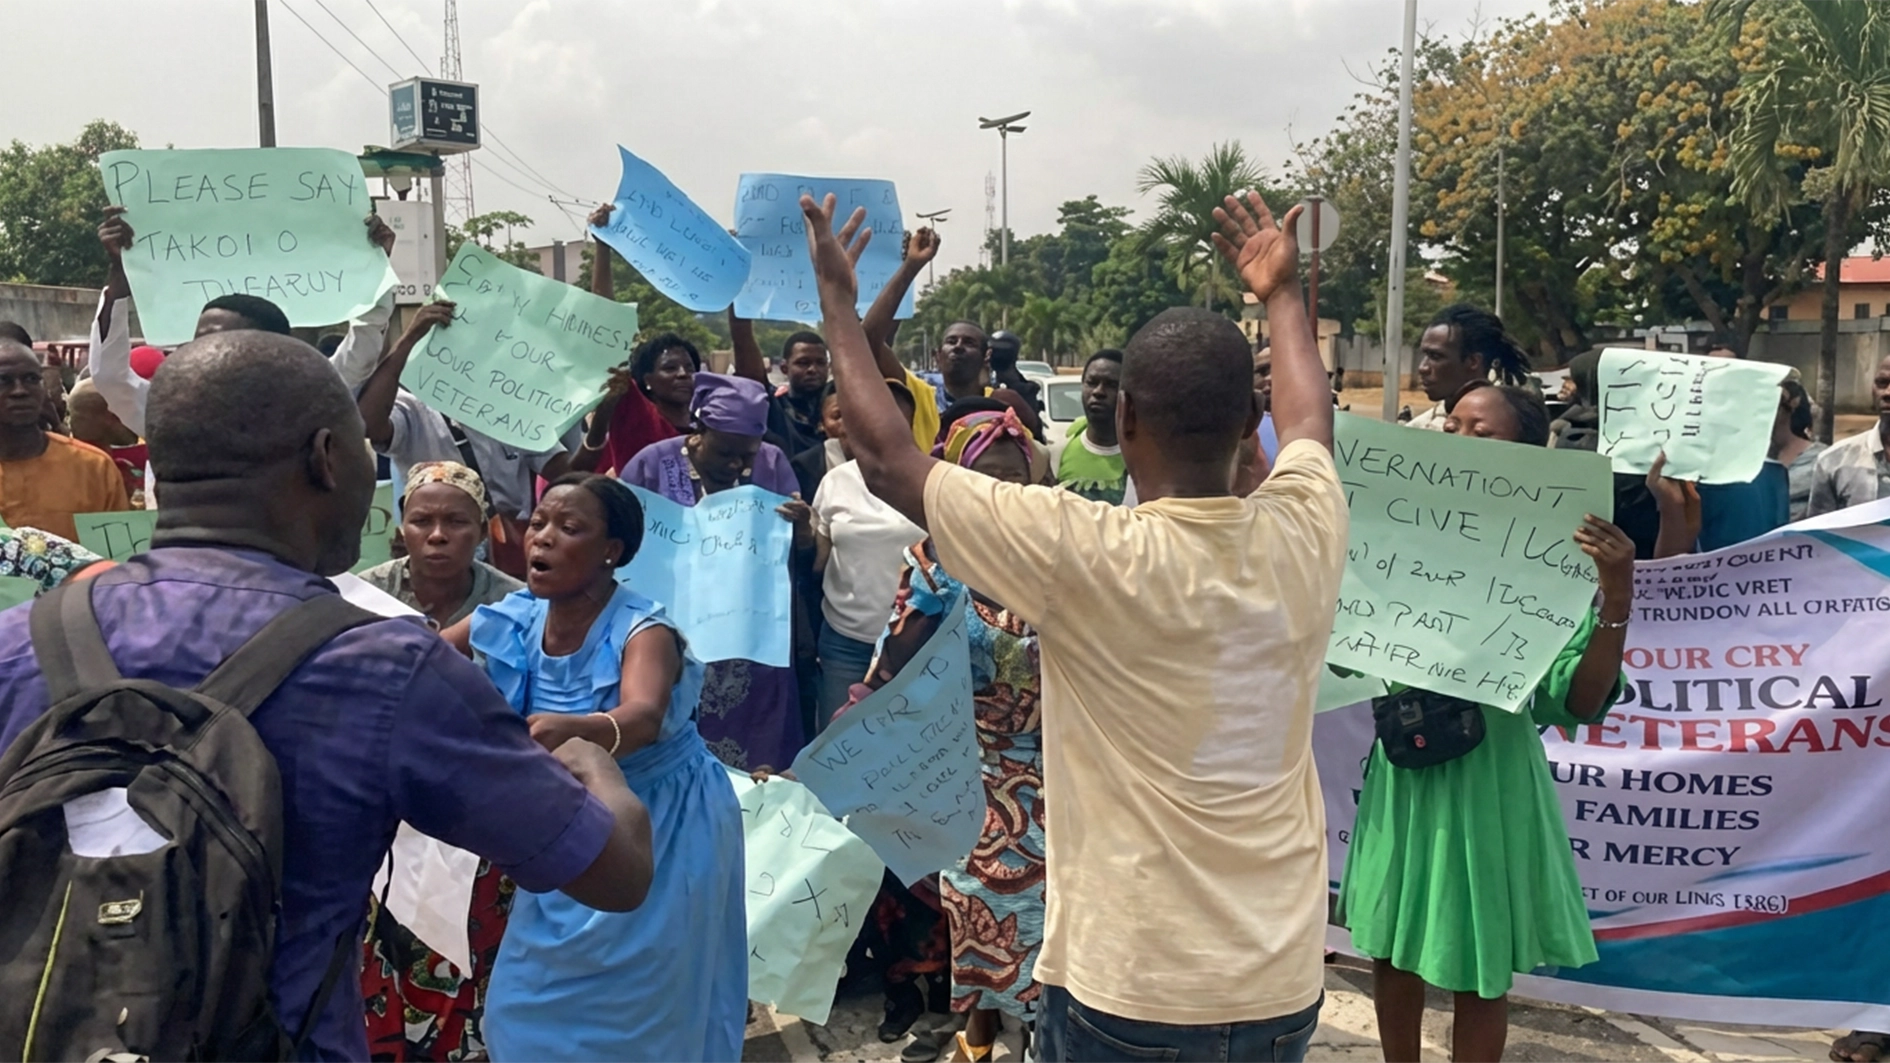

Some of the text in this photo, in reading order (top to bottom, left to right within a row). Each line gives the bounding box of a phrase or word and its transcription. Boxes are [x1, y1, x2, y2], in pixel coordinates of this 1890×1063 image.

[109, 160, 358, 206] PLEASE SAY
[418, 366, 546, 442] VETERANS
[1736, 578, 1792, 596] VRET
[1757, 601, 1797, 617] ALL
[1623, 643, 1810, 670] OUR CRY
[1557, 713, 1890, 754] ETERANS
[1621, 768, 1773, 797] HOMES
[1575, 799, 1760, 830] FAMILIES
[1603, 841, 1741, 867] MERCY
[1605, 889, 1626, 902] OF
[1633, 890, 1668, 905] OUR
